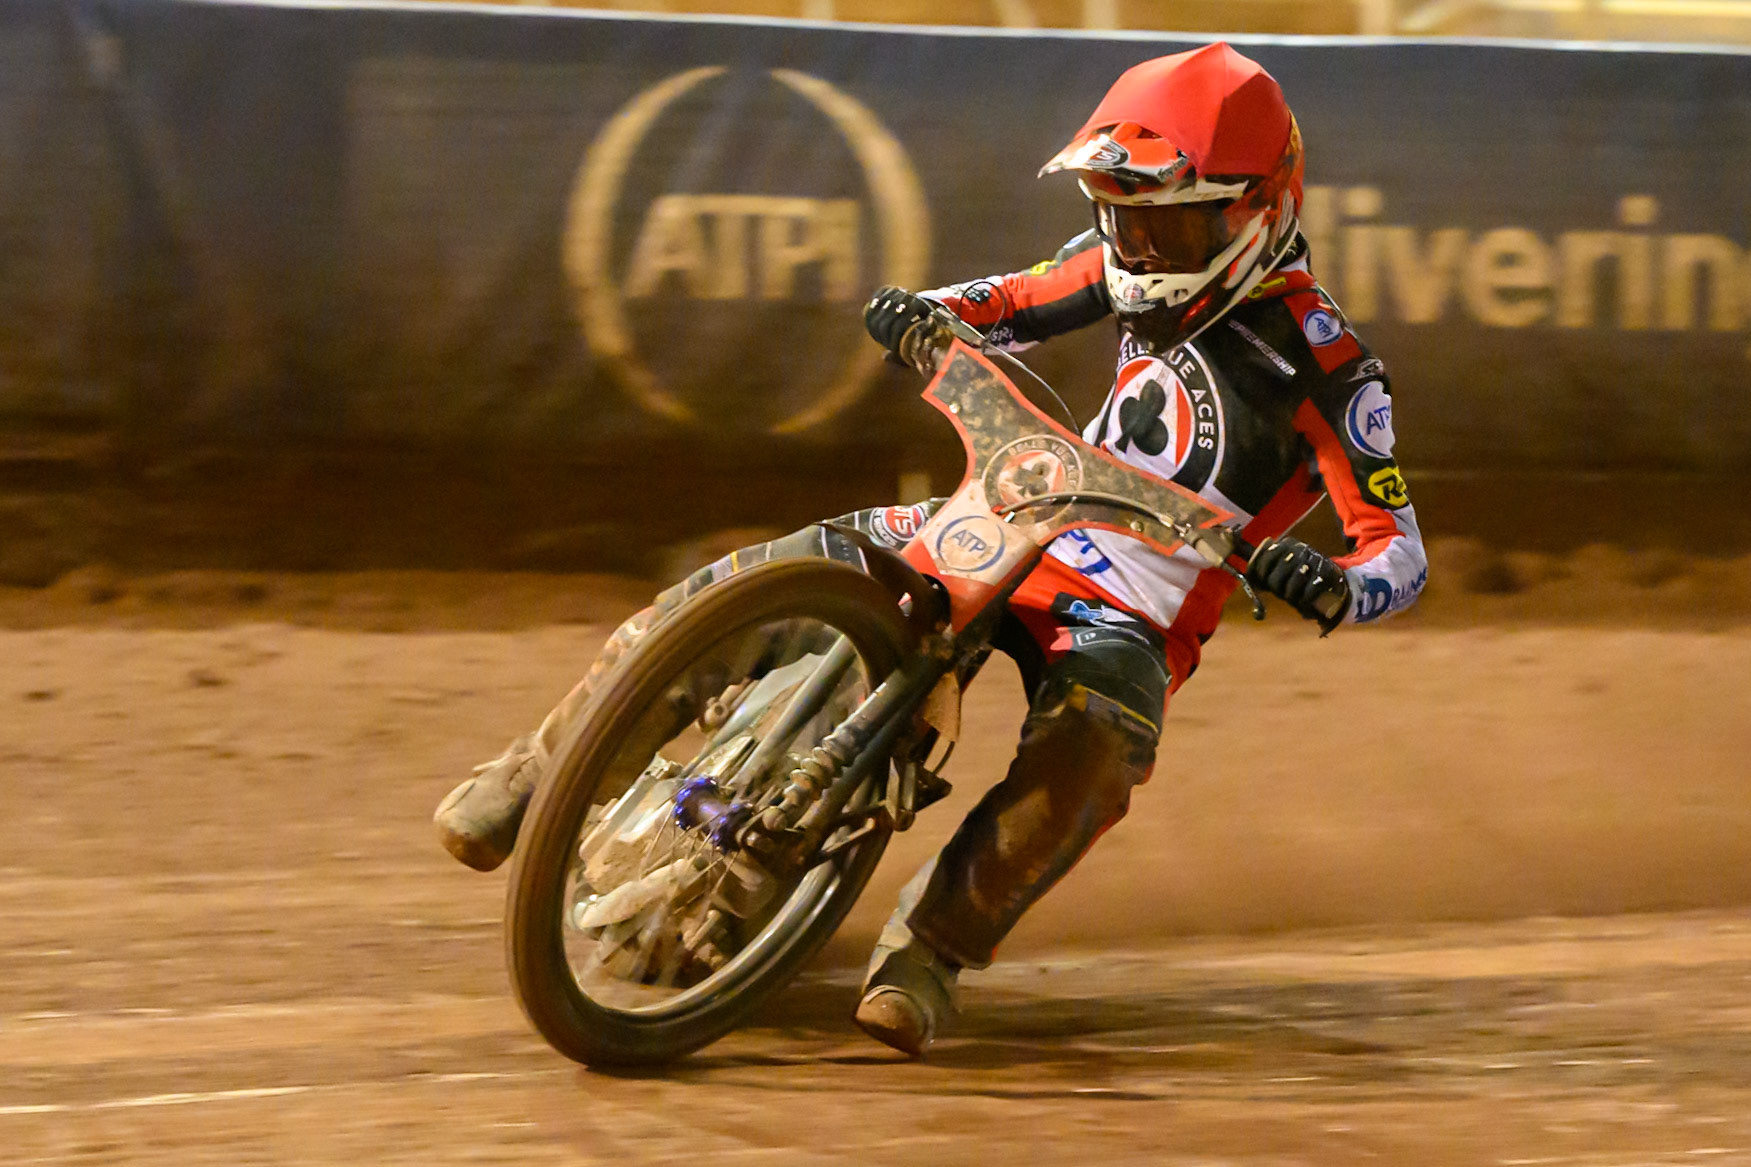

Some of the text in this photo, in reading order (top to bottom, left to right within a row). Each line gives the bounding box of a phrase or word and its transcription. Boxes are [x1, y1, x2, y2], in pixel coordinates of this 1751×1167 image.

[1303, 186, 1751, 333] liverin
[1116, 341, 1215, 450] ELL UE ACES
